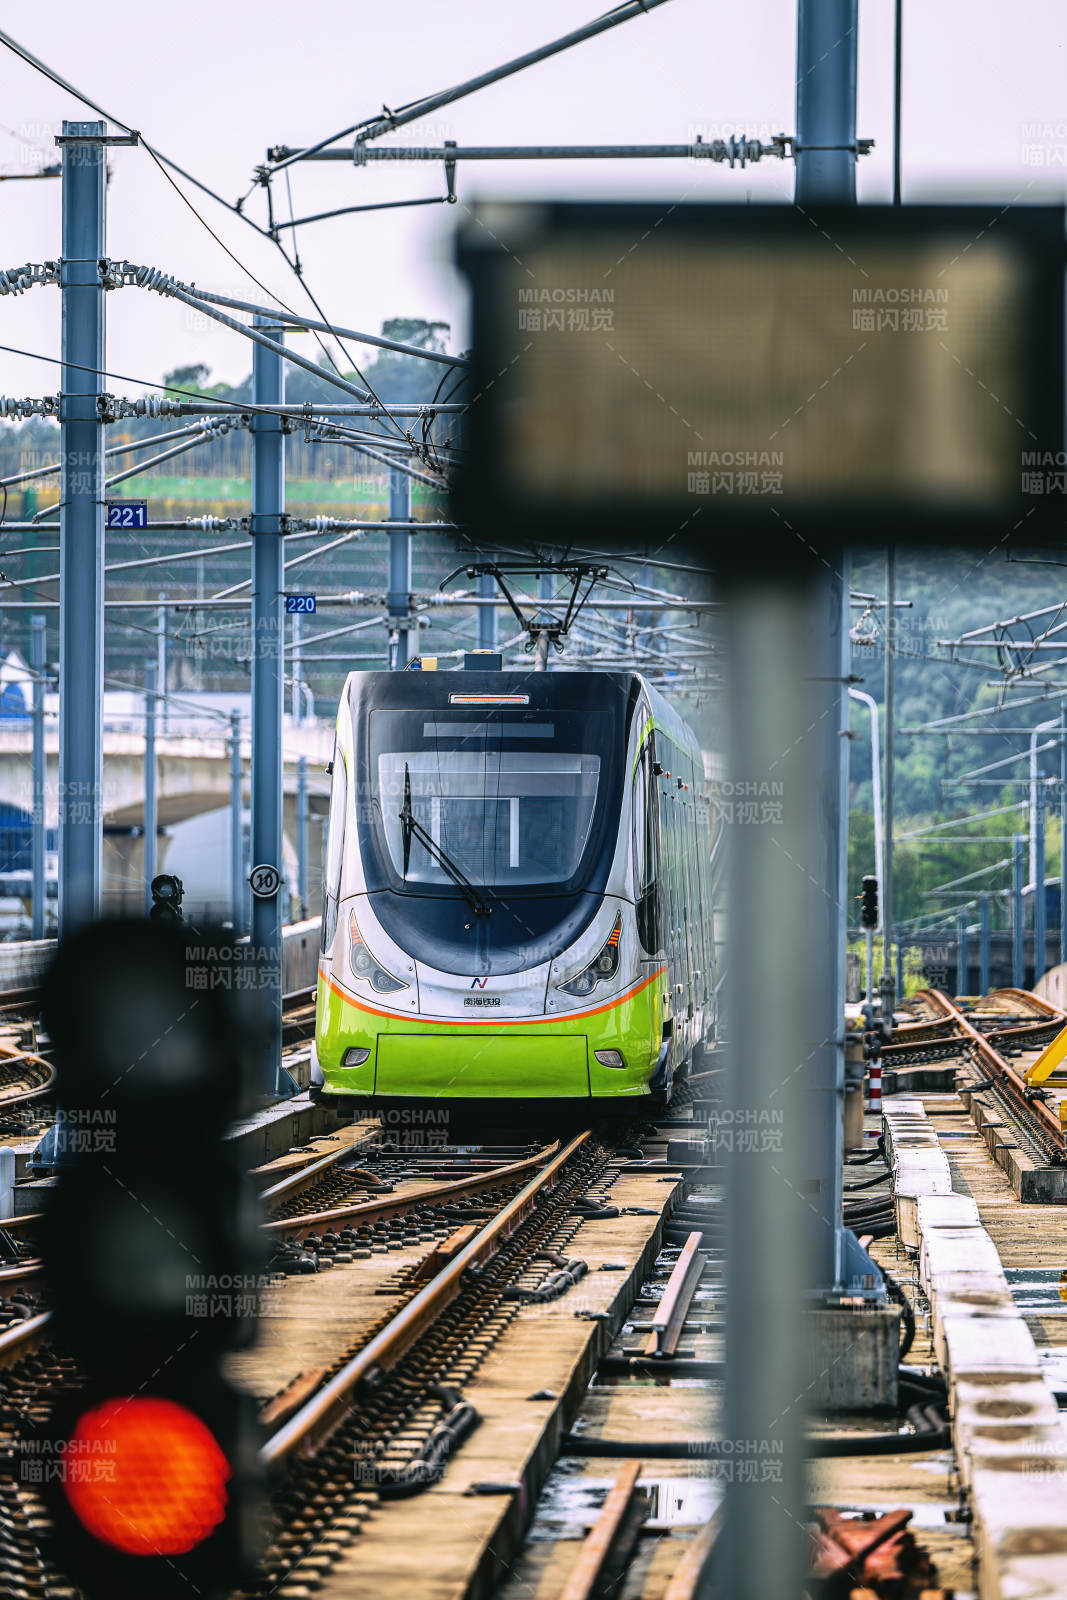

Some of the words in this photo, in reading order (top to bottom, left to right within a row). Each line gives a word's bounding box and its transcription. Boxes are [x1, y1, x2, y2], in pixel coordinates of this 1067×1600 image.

[110, 507, 144, 527] 221
[288, 597, 315, 612] 220
[256, 872, 274, 889] 10
